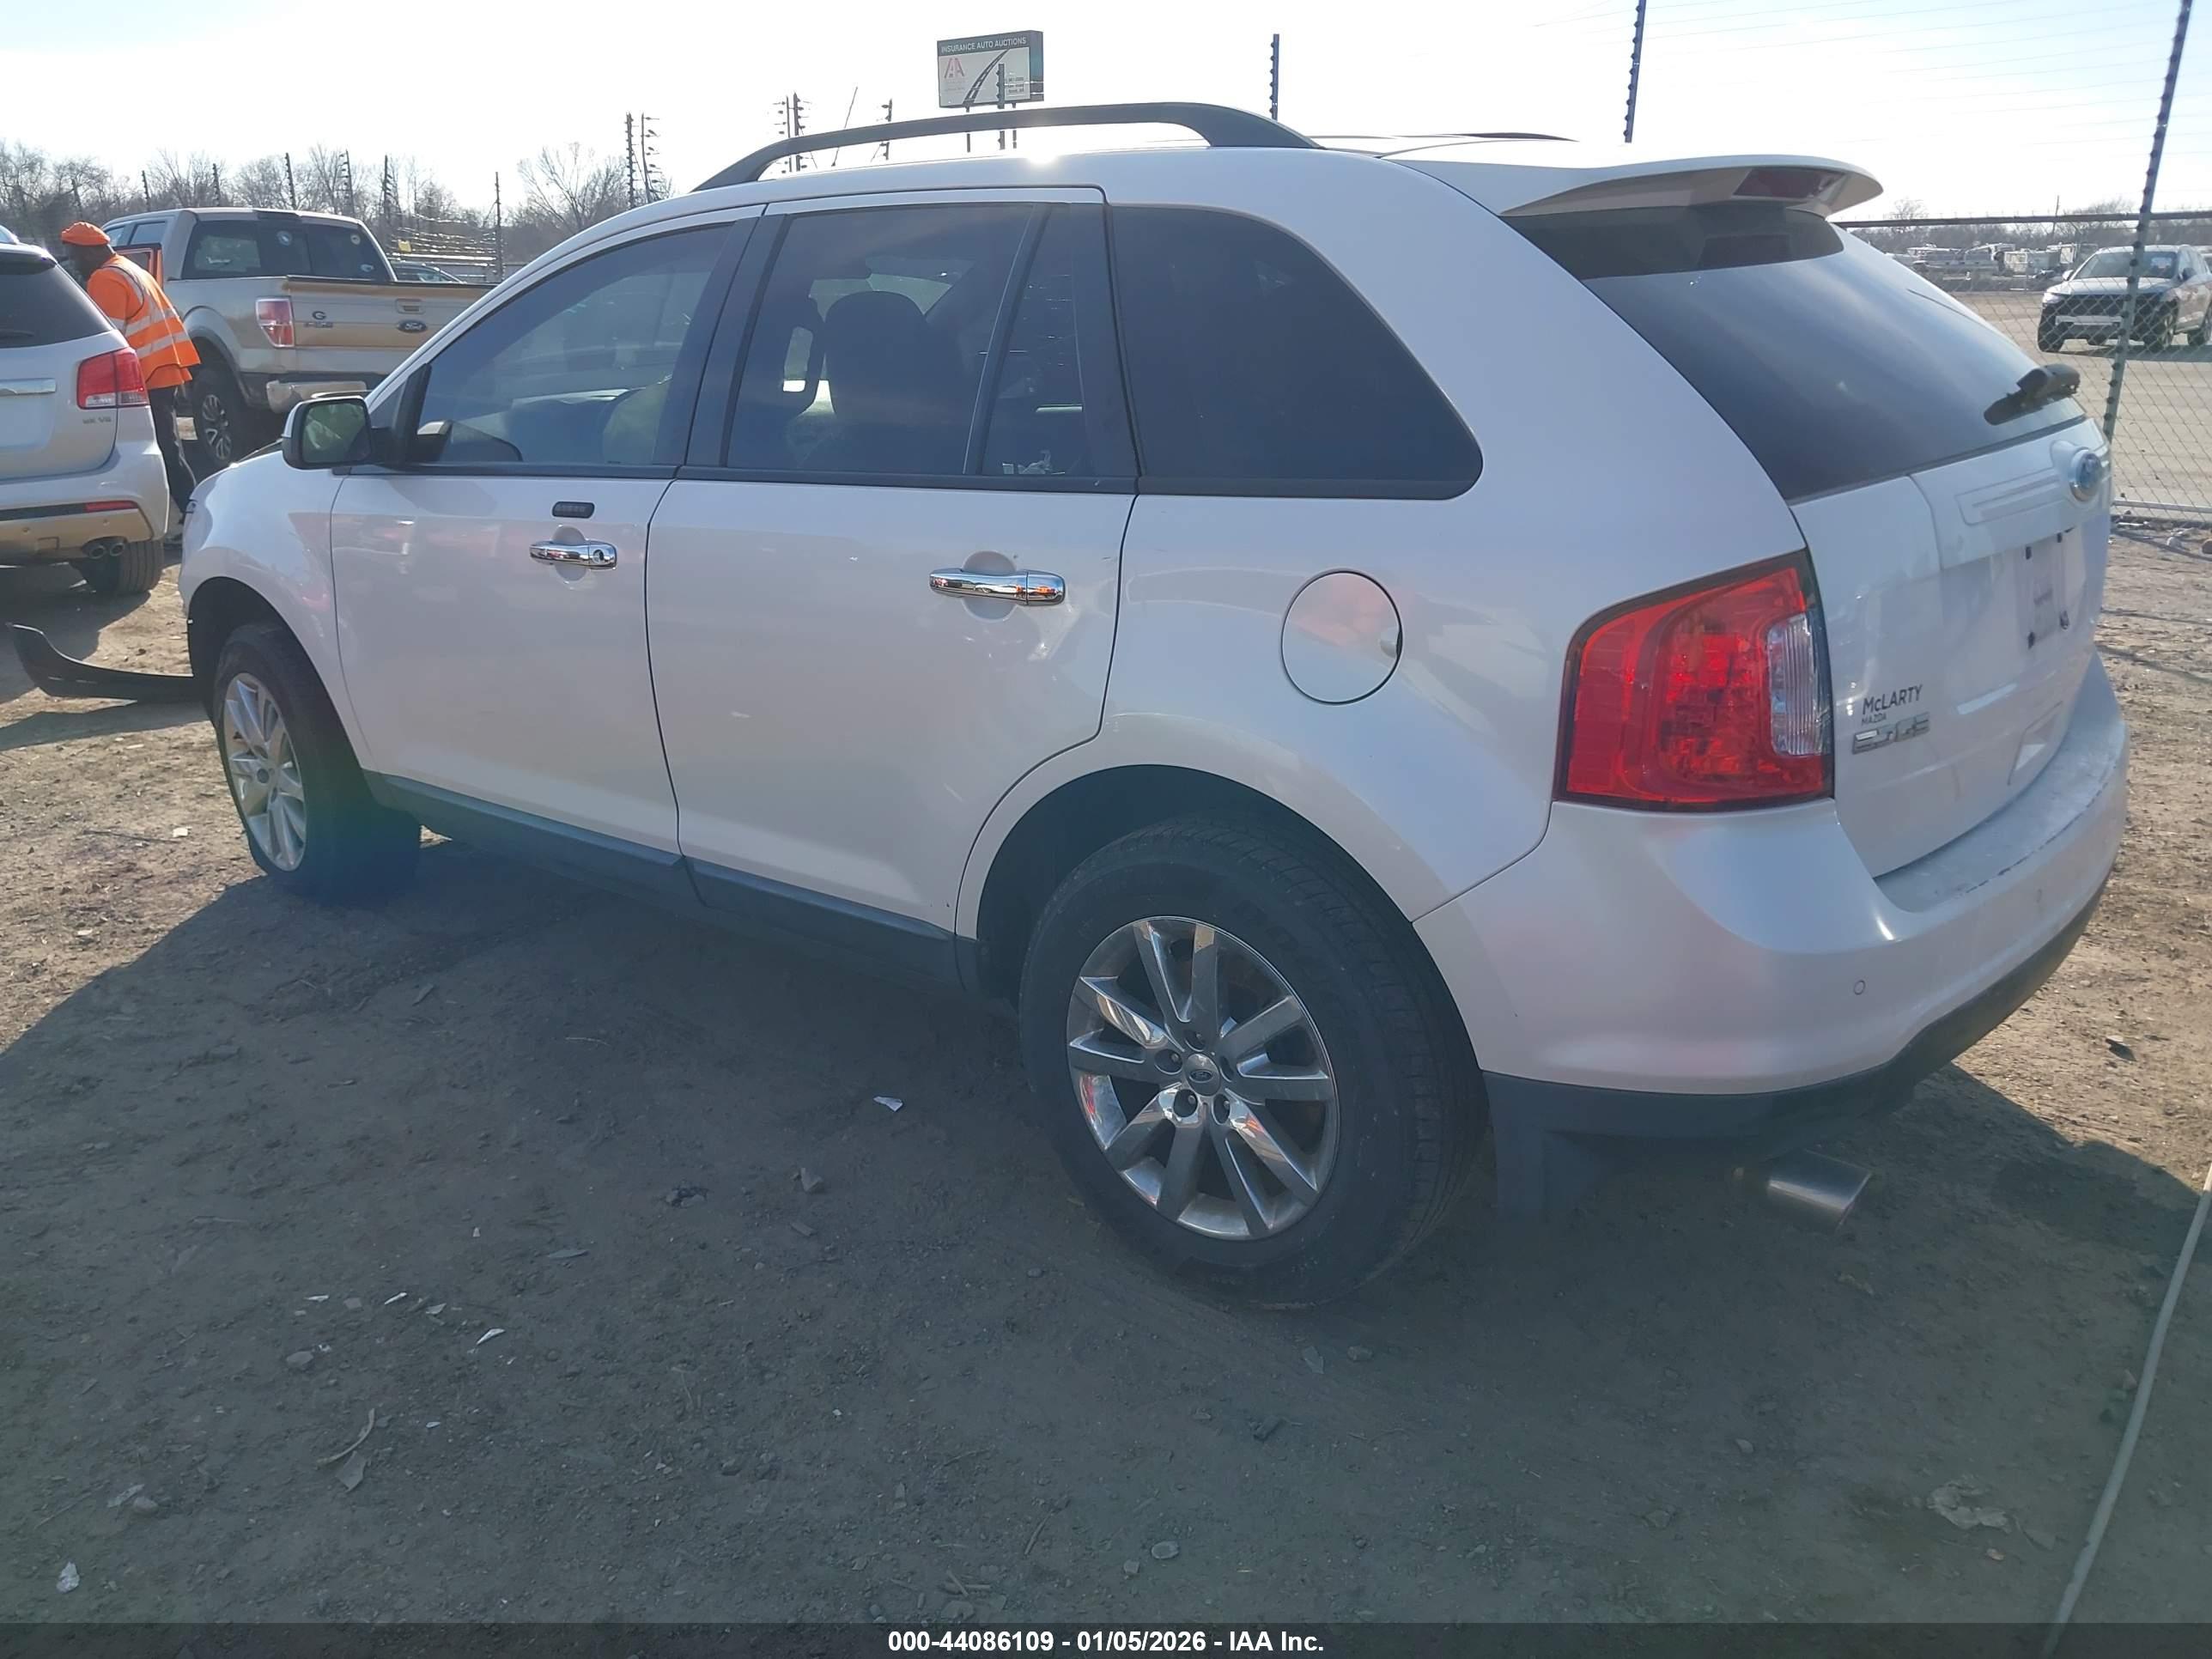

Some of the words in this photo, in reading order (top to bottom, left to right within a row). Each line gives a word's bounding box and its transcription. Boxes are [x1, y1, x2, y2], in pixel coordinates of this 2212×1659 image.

[941, 42, 975, 53] INSURANCE
[976, 40, 994, 49] AUTO
[994, 36, 1027, 47] AUCTIONS
